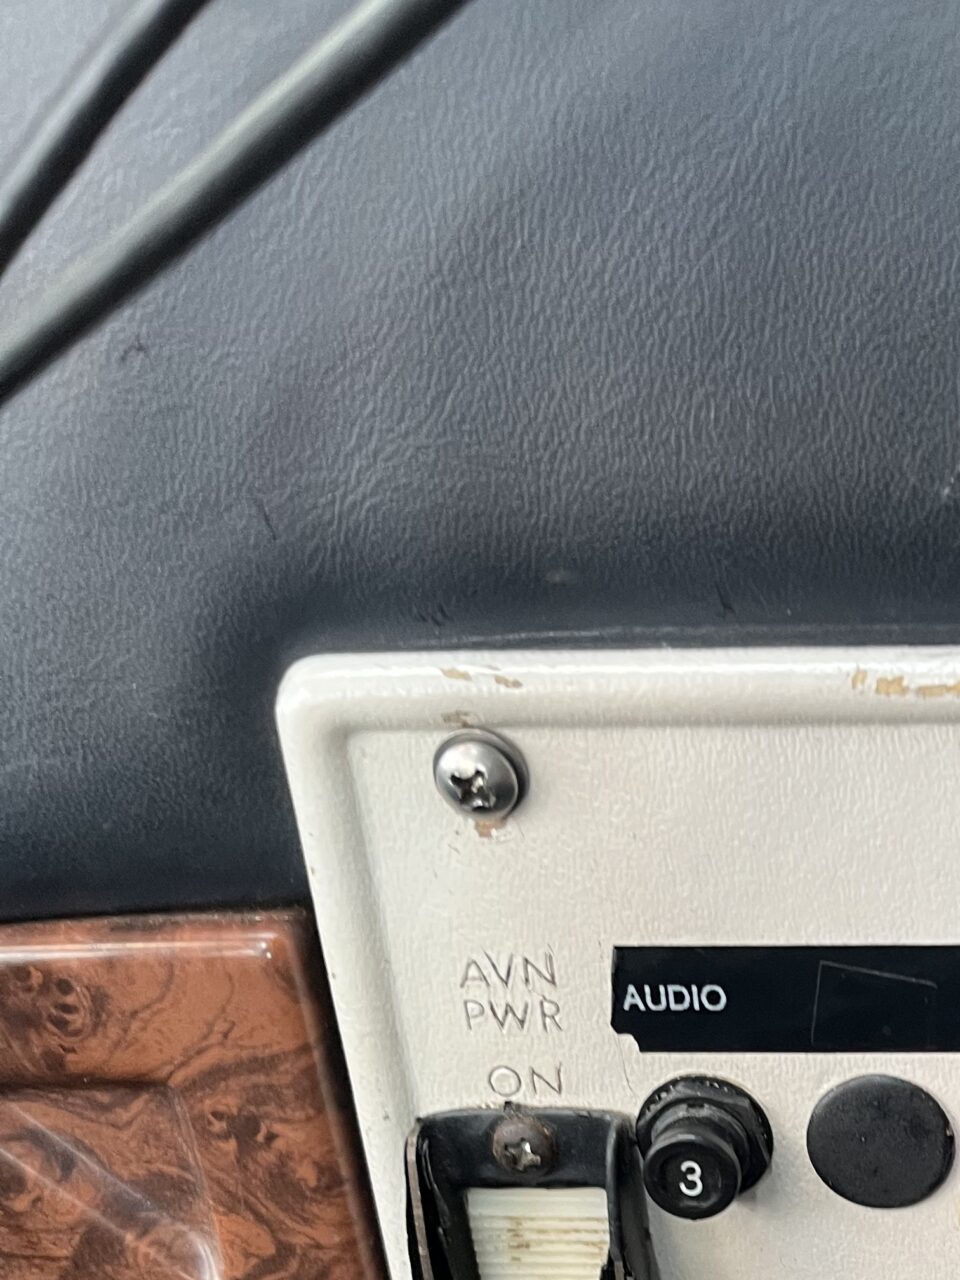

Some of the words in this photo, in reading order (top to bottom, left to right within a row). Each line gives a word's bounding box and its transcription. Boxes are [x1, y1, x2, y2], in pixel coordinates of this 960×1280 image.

[460, 947, 558, 988] AVN
[463, 997, 564, 1033] PWR
[623, 984, 727, 1011] AUDIO
[488, 1062, 562, 1097] ON
[678, 1160, 704, 1197] 3
